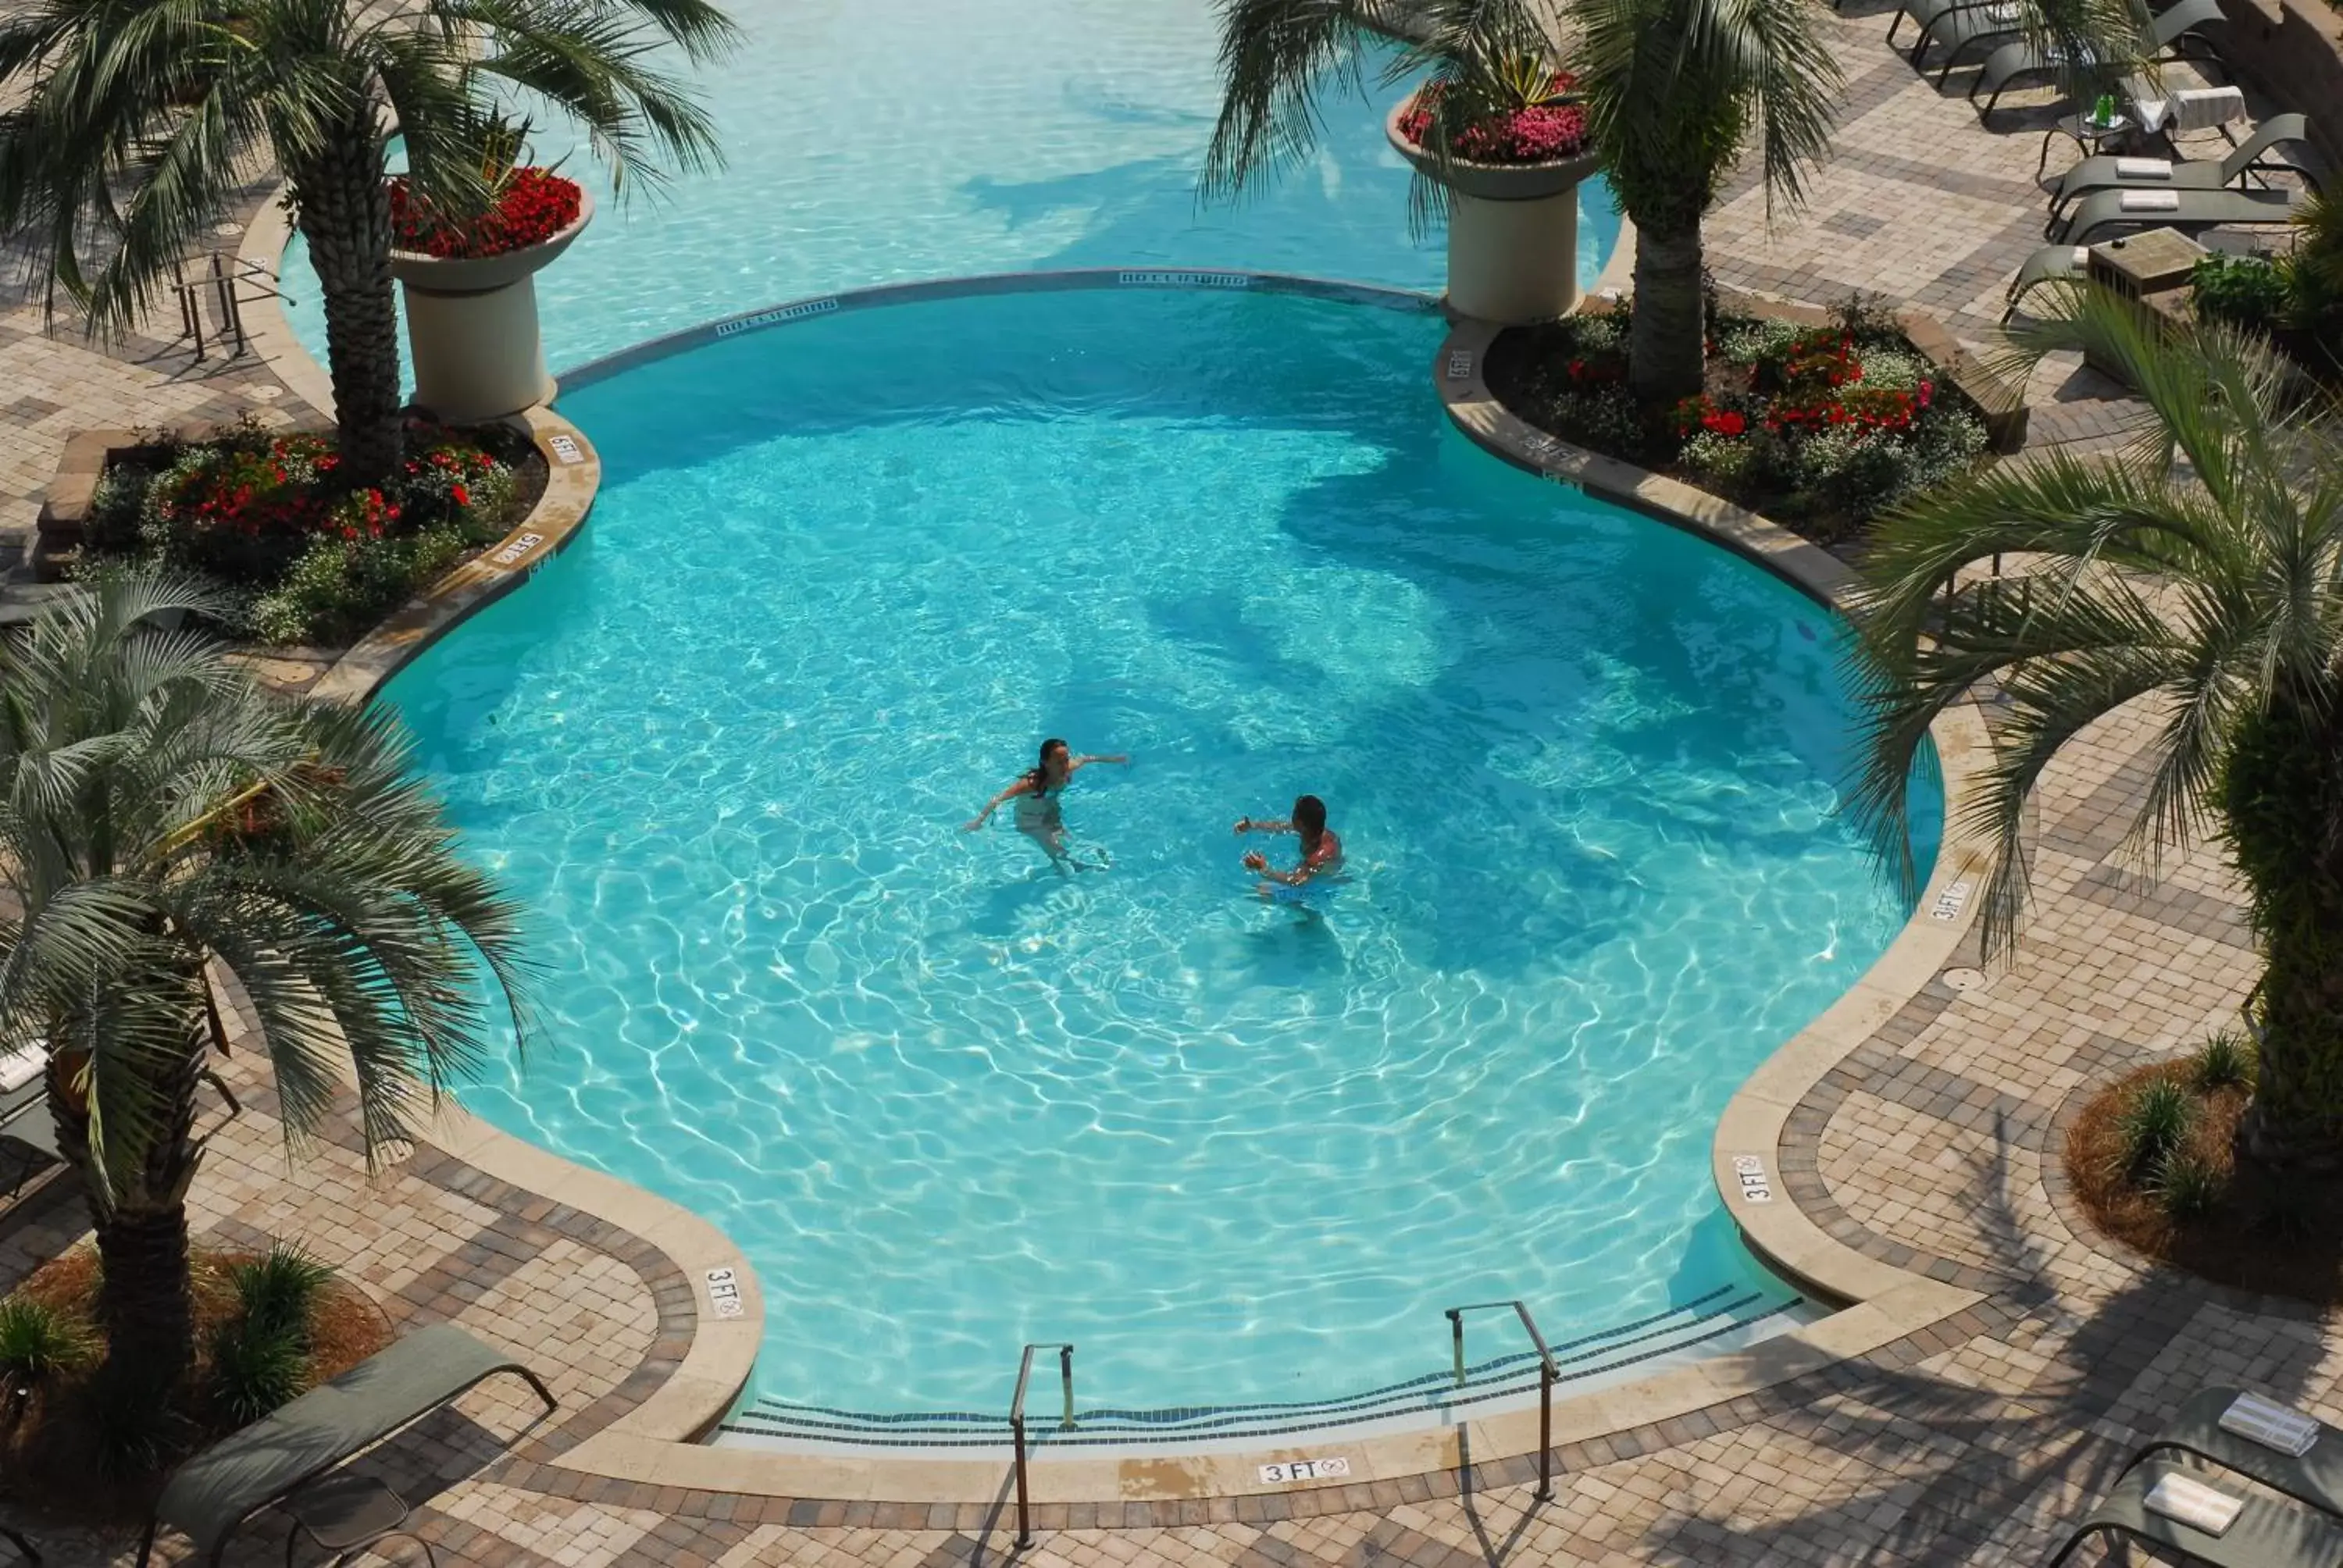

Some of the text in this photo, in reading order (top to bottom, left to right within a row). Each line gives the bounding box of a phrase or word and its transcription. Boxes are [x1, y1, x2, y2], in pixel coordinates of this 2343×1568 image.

[1739, 1172, 1770, 1199] 3 FT
[708, 1270, 738, 1299] 3 FT
[1266, 1461, 1316, 1482] 3 FT
